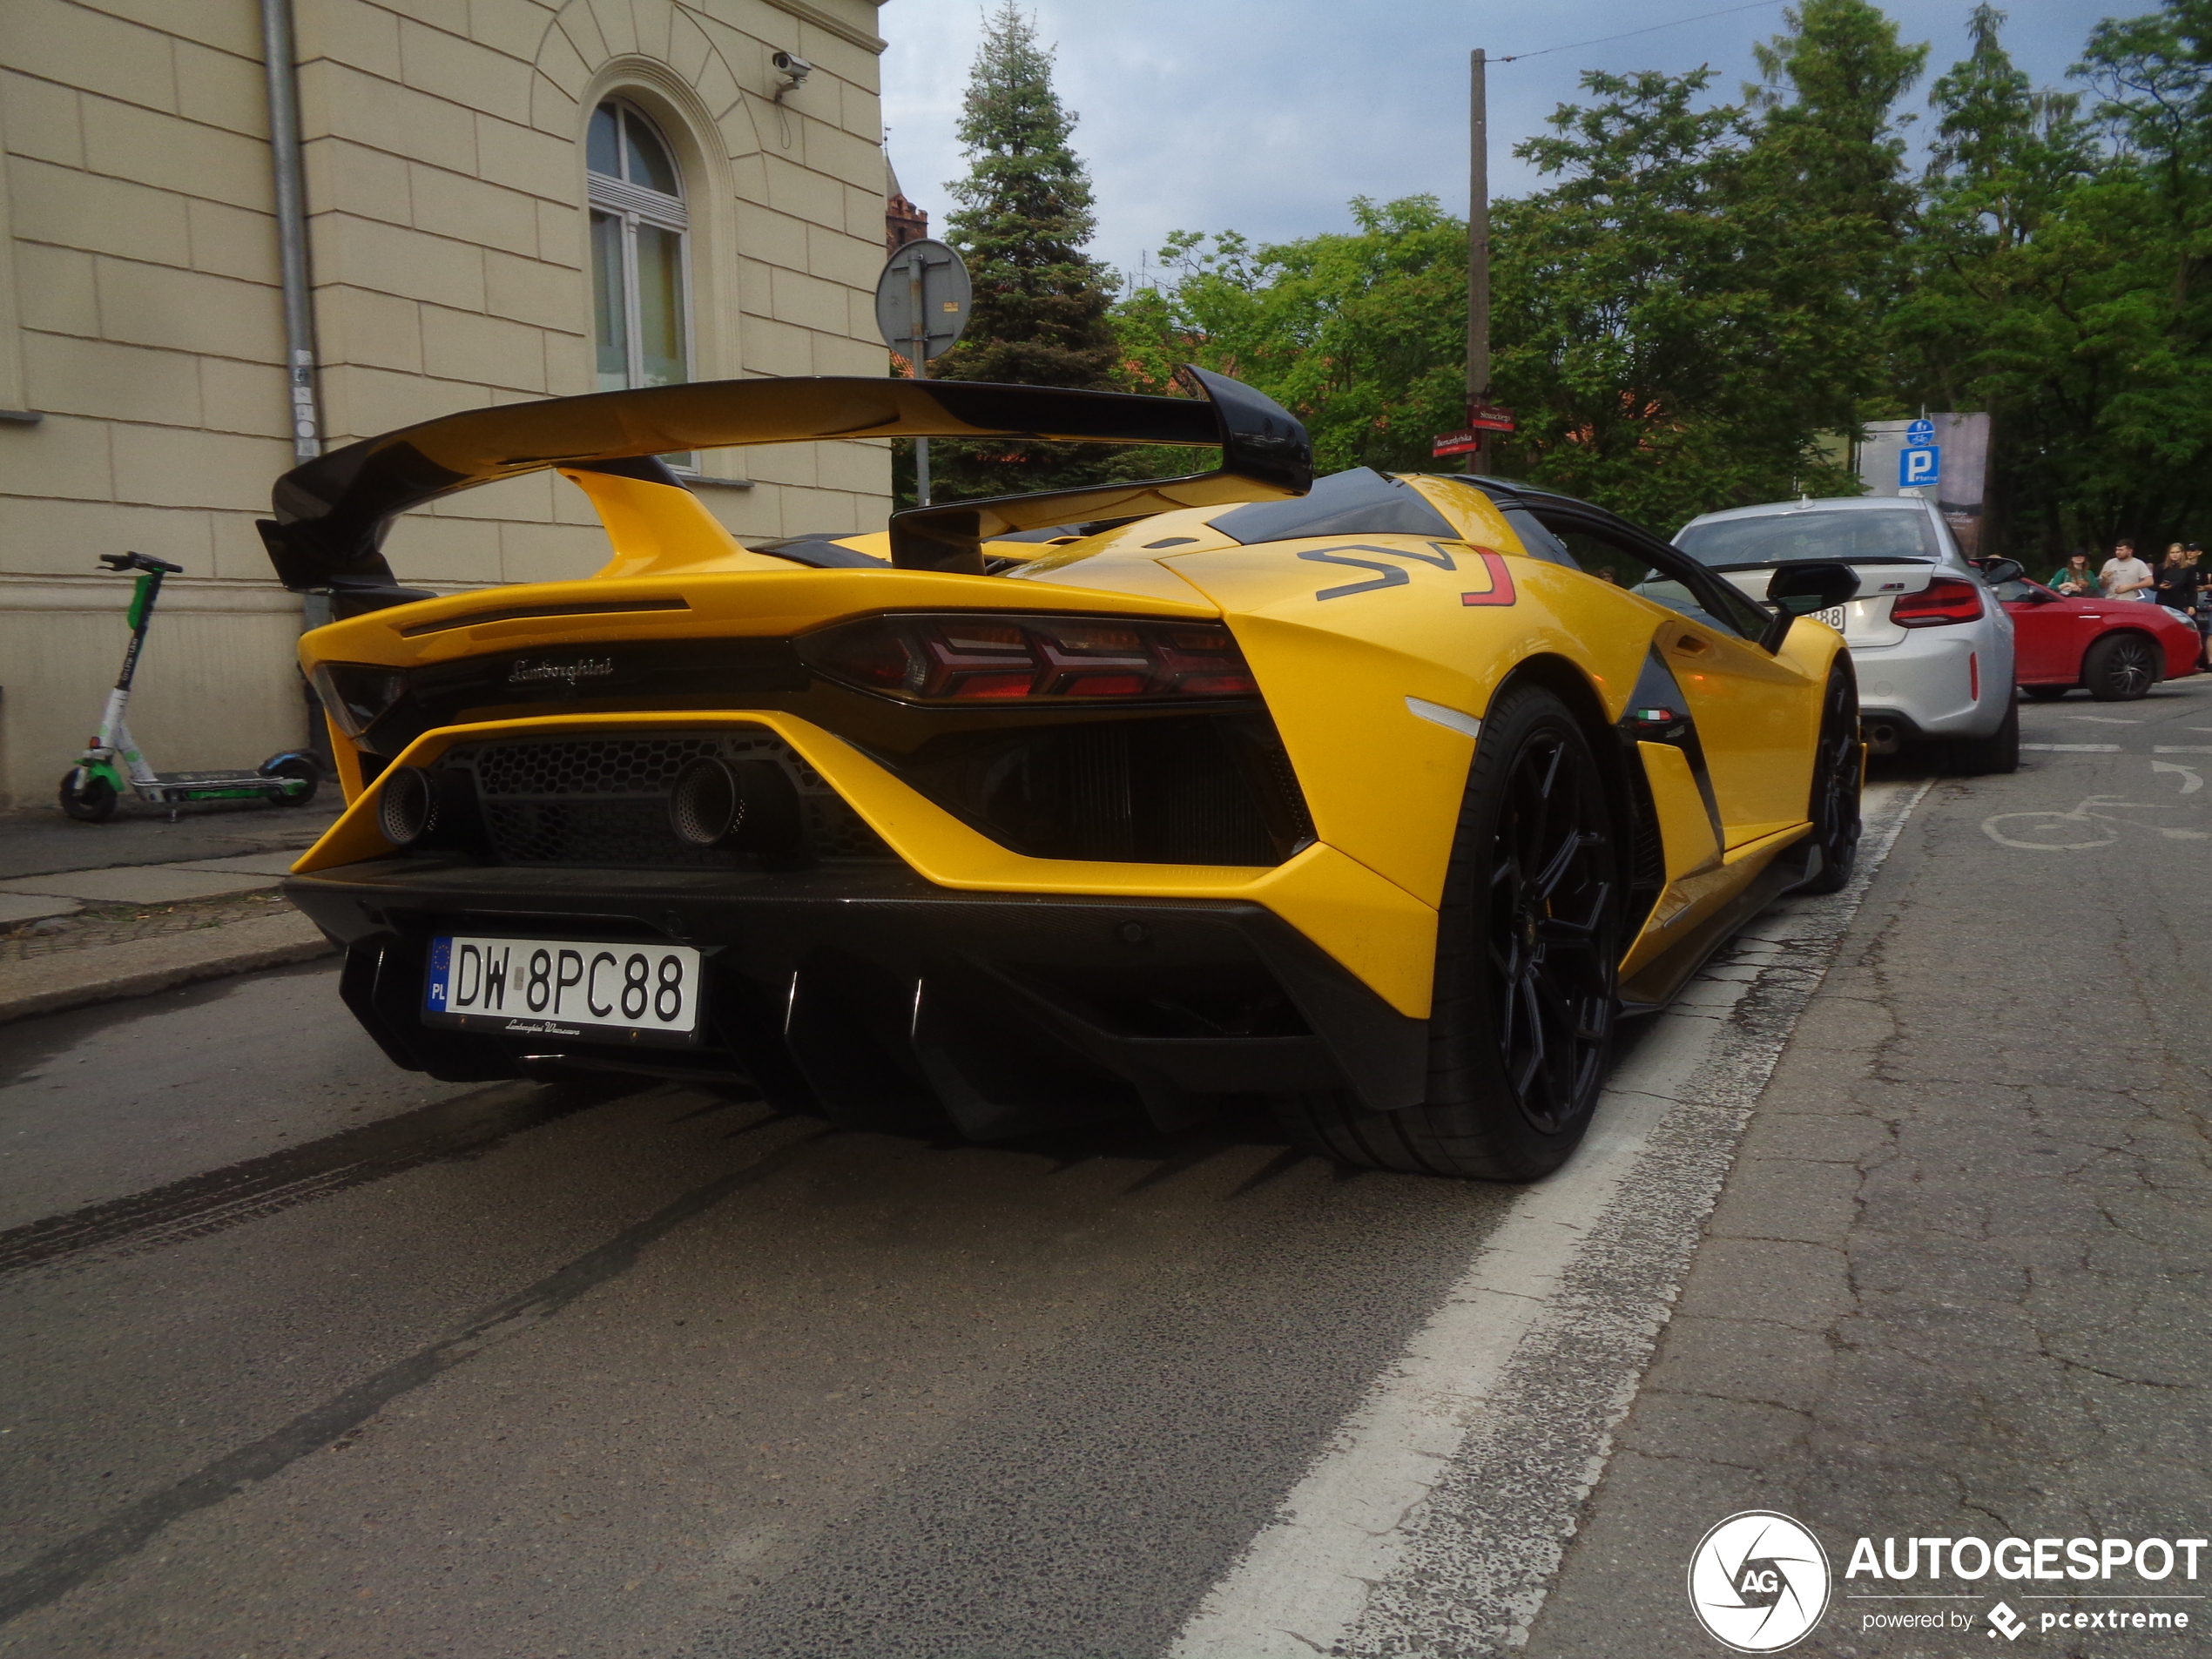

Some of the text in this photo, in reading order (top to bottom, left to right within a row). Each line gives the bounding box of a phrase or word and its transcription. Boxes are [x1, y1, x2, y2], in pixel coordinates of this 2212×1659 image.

[1437, 434, 1472, 447] Bernardyńska
[1908, 450, 1932, 482] P
[1297, 541, 1516, 607] SVJ
[509, 658, 613, 686] Lamborghini
[431, 983, 446, 1001] PL
[456, 944, 684, 1022] DW 8PC88
